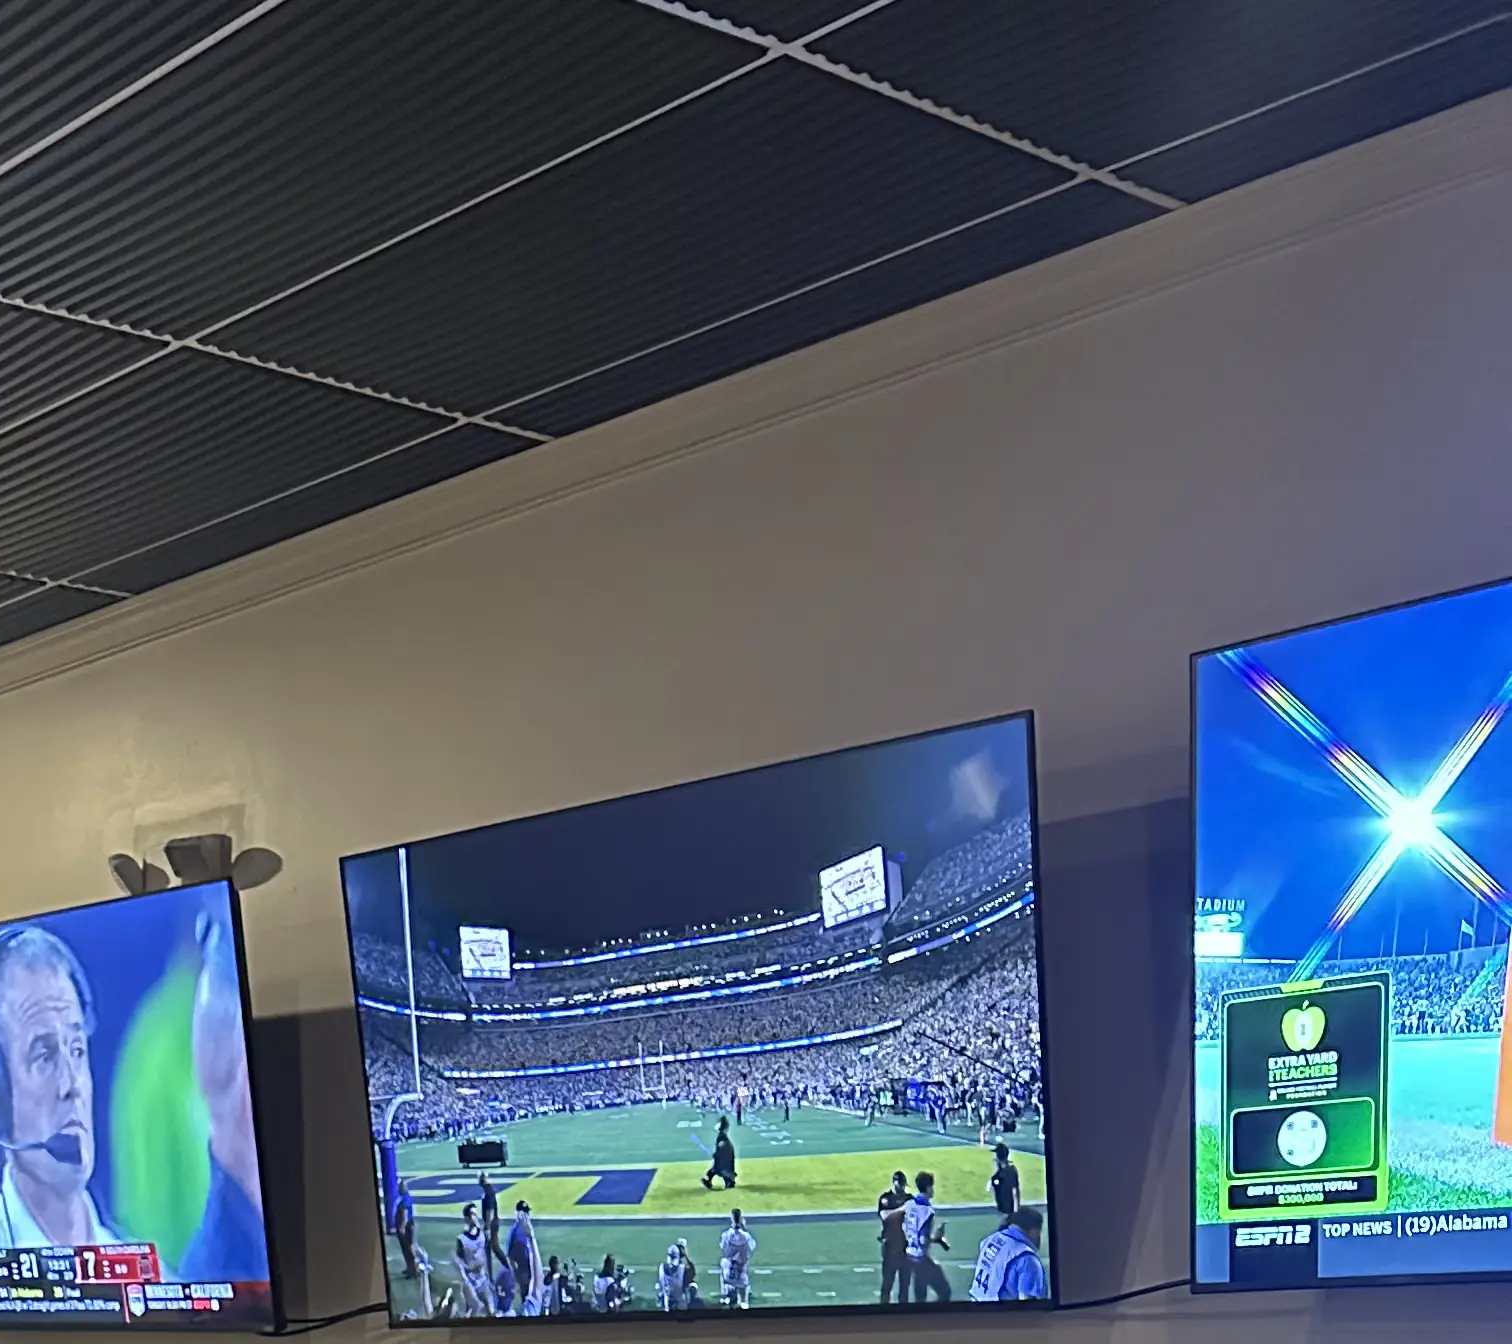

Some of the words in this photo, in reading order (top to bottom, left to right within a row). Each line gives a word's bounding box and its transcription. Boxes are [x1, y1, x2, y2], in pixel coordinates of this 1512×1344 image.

[1268, 1054, 1306, 1069] EXTRA
[1306, 1051, 1338, 1065] YARD
[1274, 1063, 1337, 1081] TEACHERS
[1322, 1223, 1351, 1238] TOP
[1352, 1221, 1392, 1236] NEWS
[1405, 1213, 1508, 1237] (19)Alabama
[19, 1252, 39, 1279] 21
[975, 1268, 990, 1295] 44
